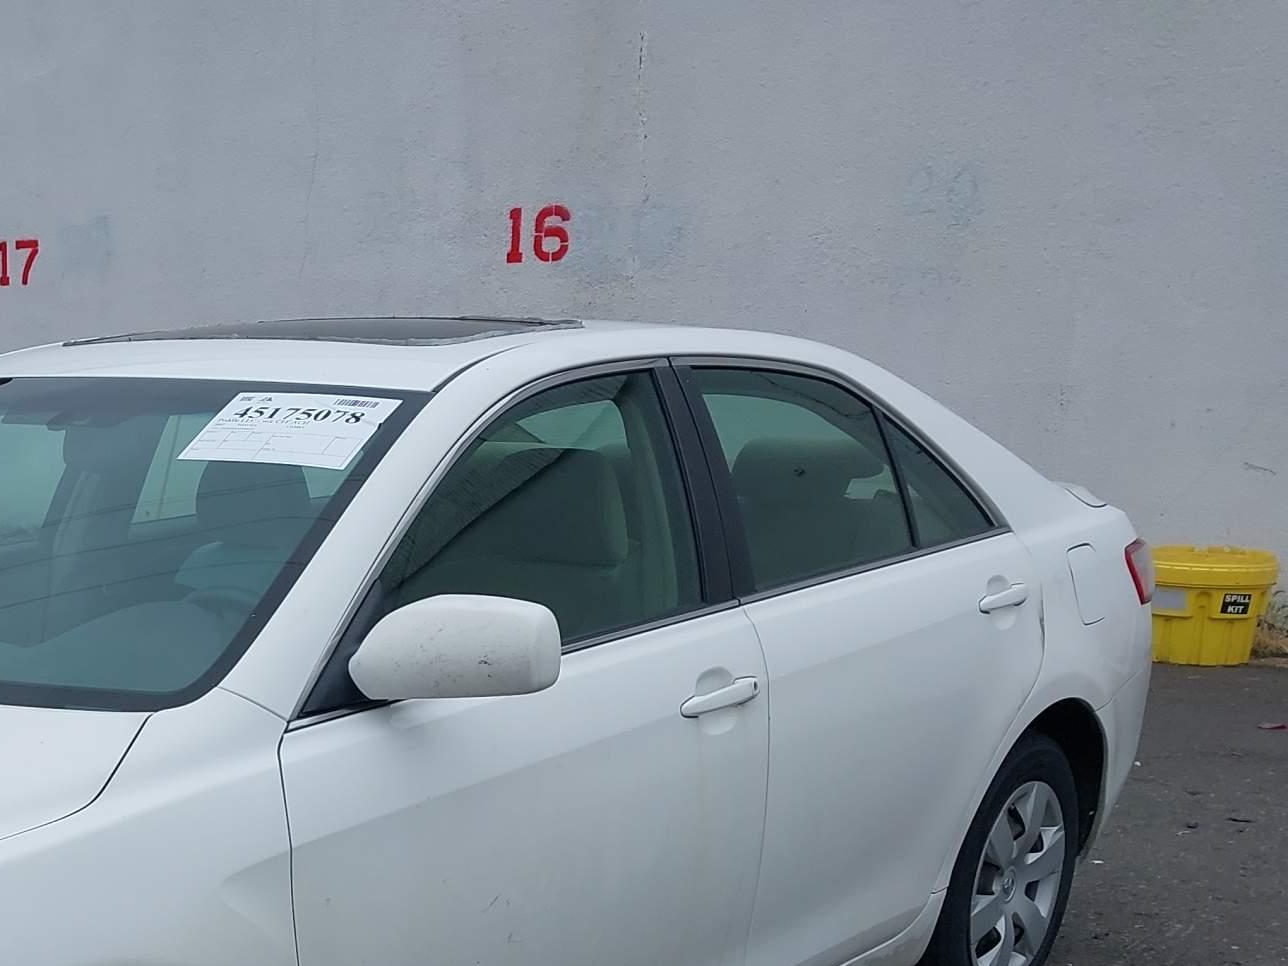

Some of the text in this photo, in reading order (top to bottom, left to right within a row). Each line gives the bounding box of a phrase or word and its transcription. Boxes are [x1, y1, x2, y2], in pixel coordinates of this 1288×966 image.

[506, 205, 570, 264] 16
[0, 240, 39, 287] 17
[234, 406, 365, 424] 45175078
[1224, 594, 1250, 603] SPILL
[1227, 605, 1245, 614] KIT
